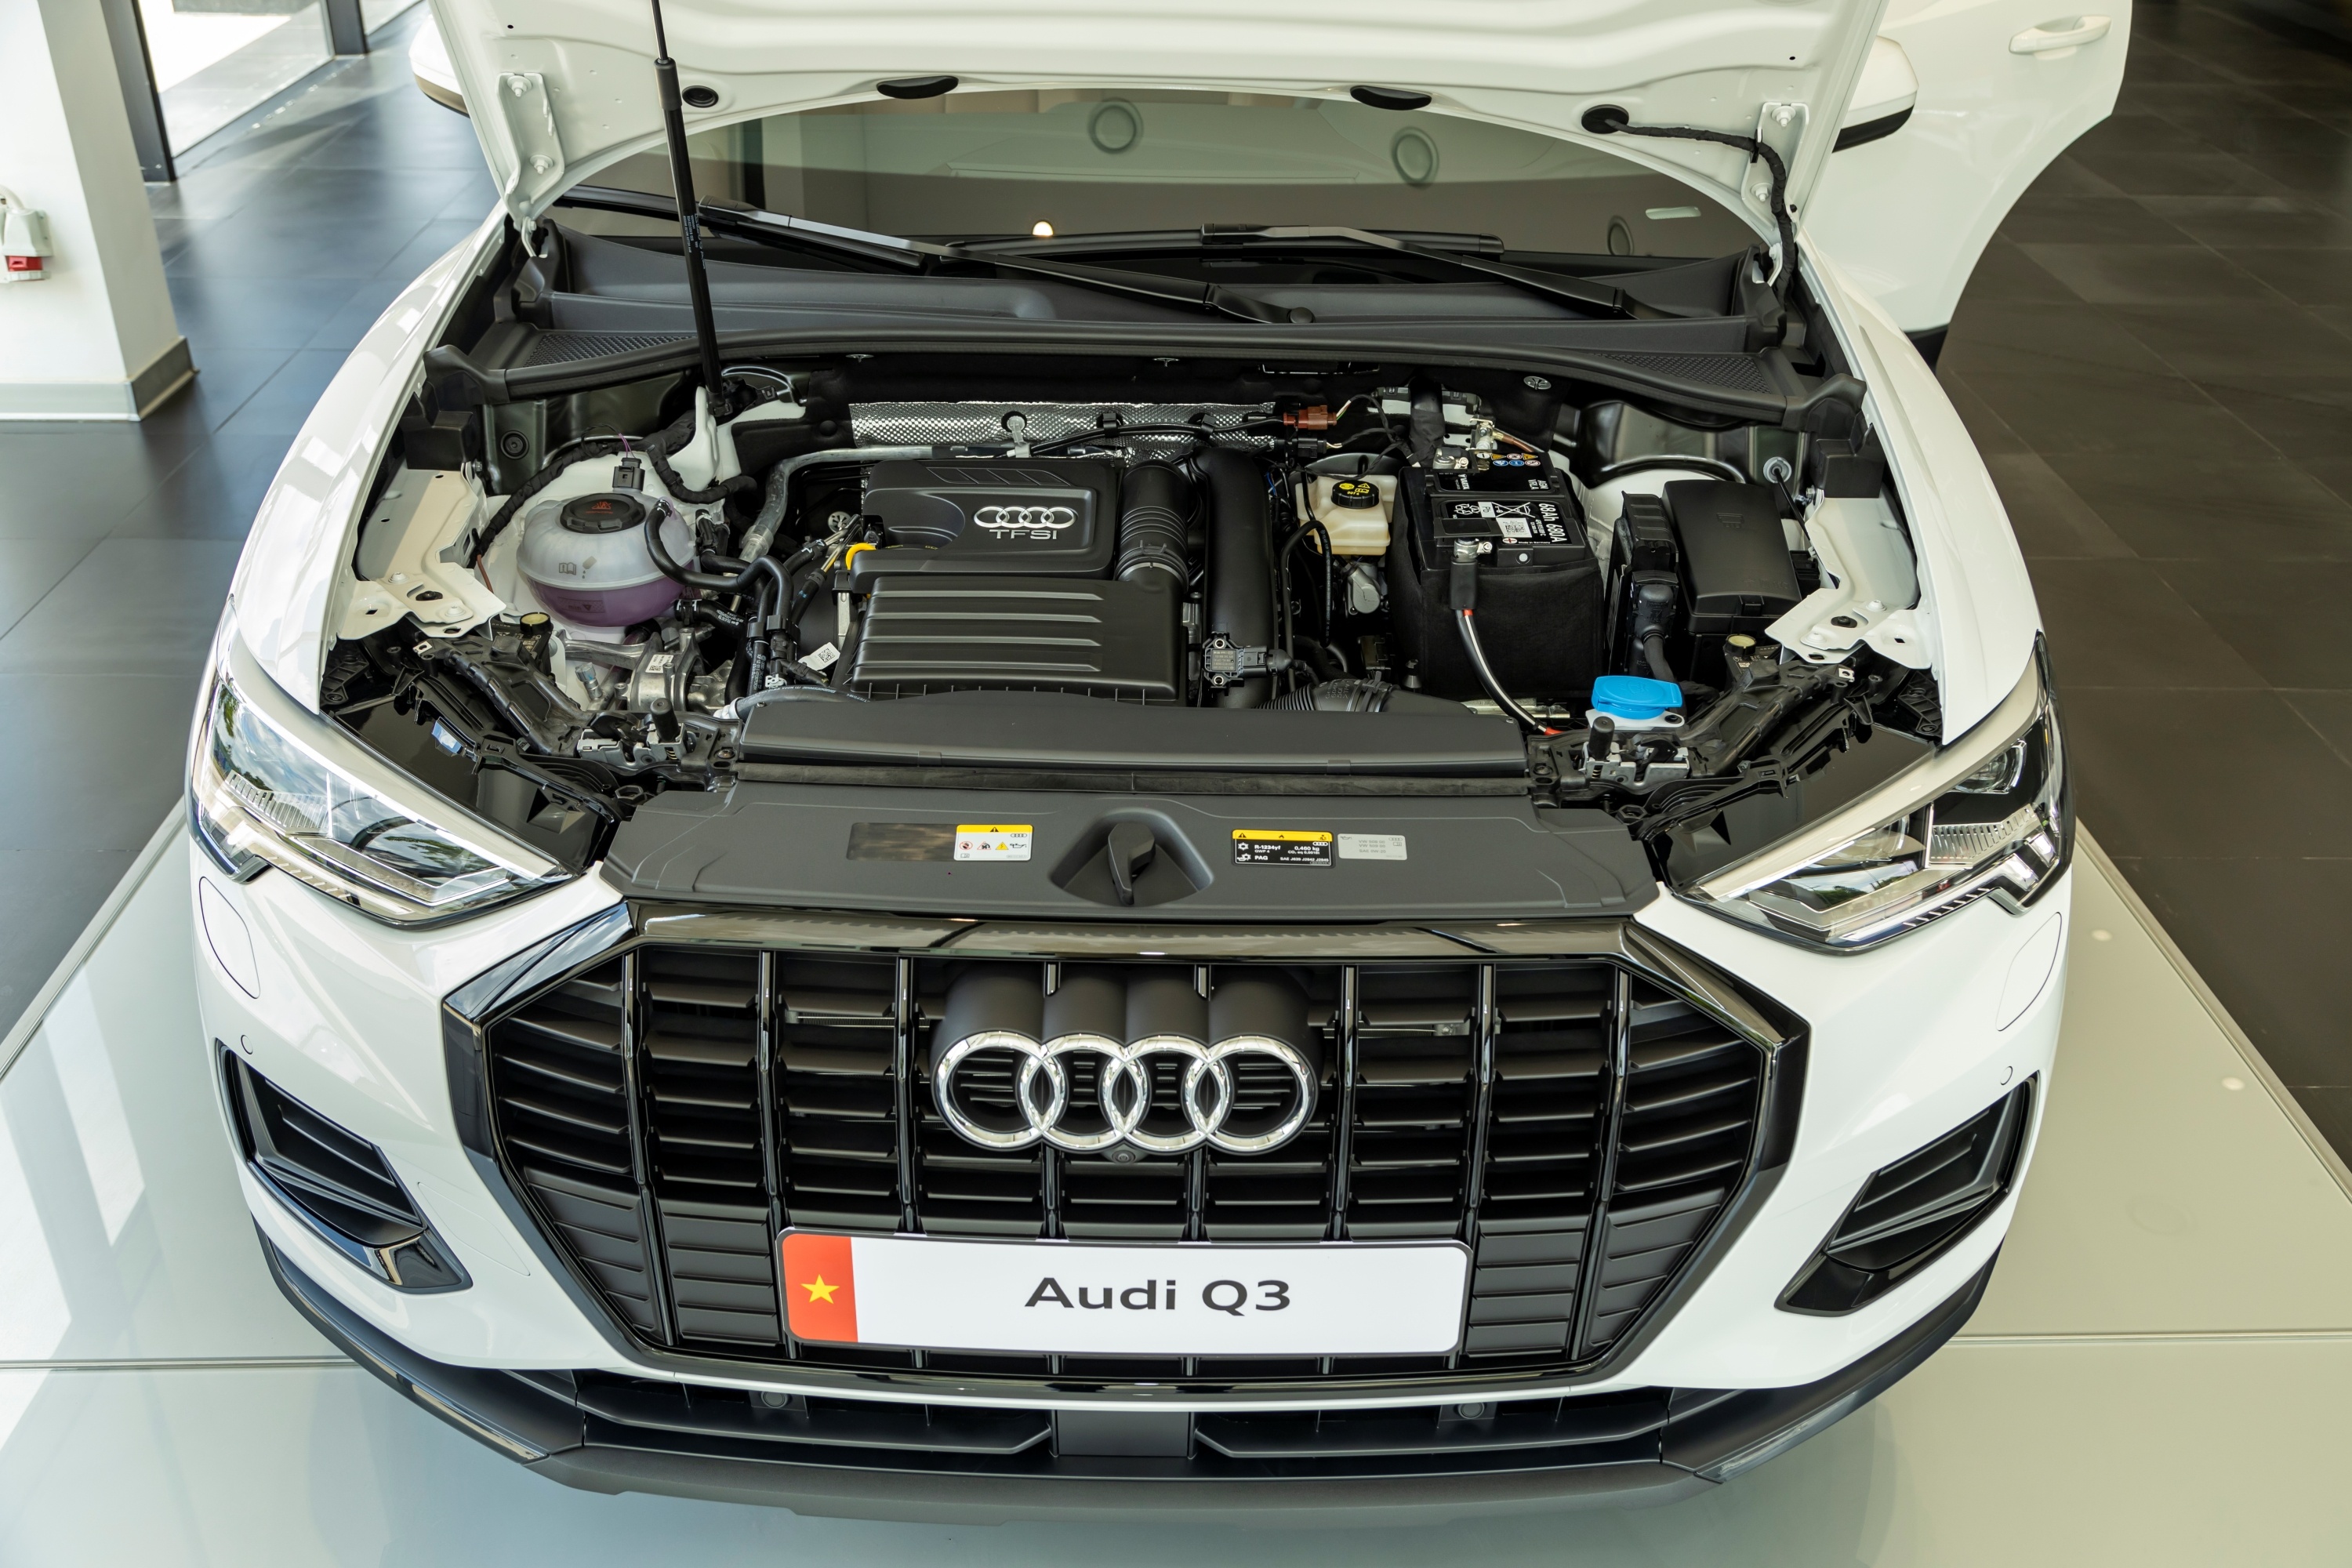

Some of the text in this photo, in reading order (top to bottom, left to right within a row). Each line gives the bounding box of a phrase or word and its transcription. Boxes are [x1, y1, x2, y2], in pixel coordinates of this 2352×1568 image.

[1538, 503, 1559, 521] 68Ah
[989, 529, 1057, 539] TFSI
[1546, 524, 1567, 543] 680A
[1024, 1277, 1290, 1316] Audi Q3
